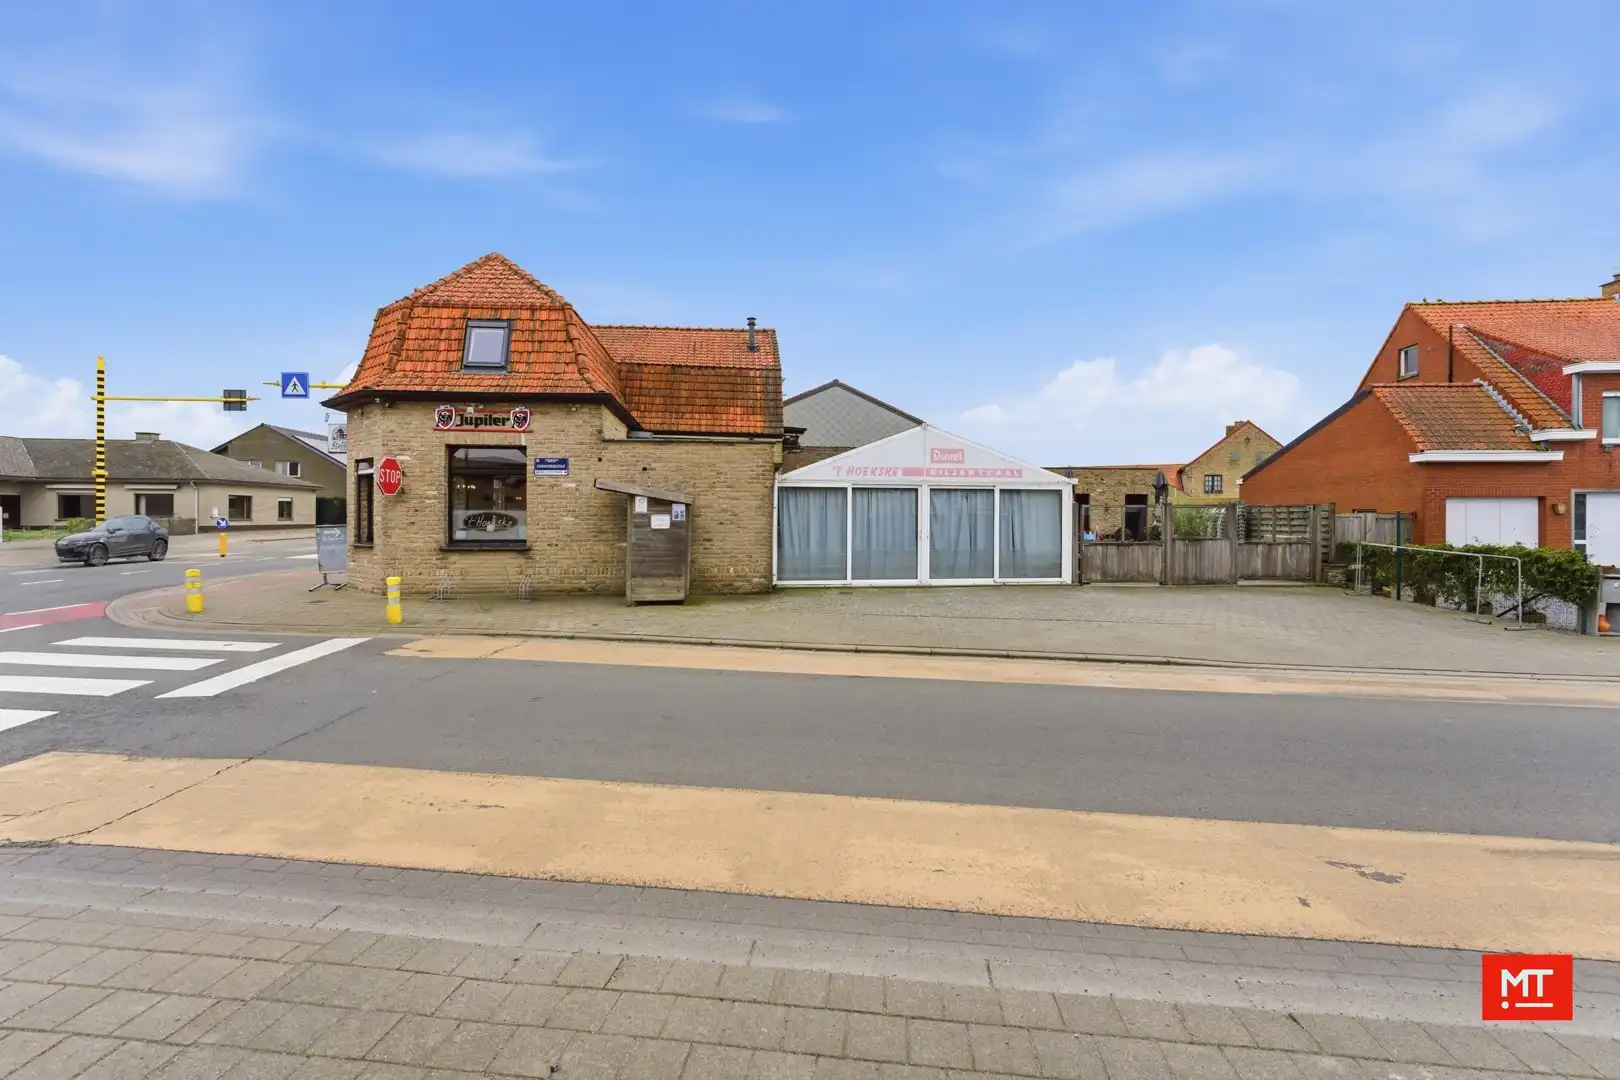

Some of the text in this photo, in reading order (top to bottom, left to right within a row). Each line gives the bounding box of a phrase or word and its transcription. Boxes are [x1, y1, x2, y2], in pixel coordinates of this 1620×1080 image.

[455, 413, 511, 429] Jupiler
[933, 449, 963, 461] Duvel
[379, 468, 401, 484] STOP
[847, 466, 899, 477] HOEKSKE
